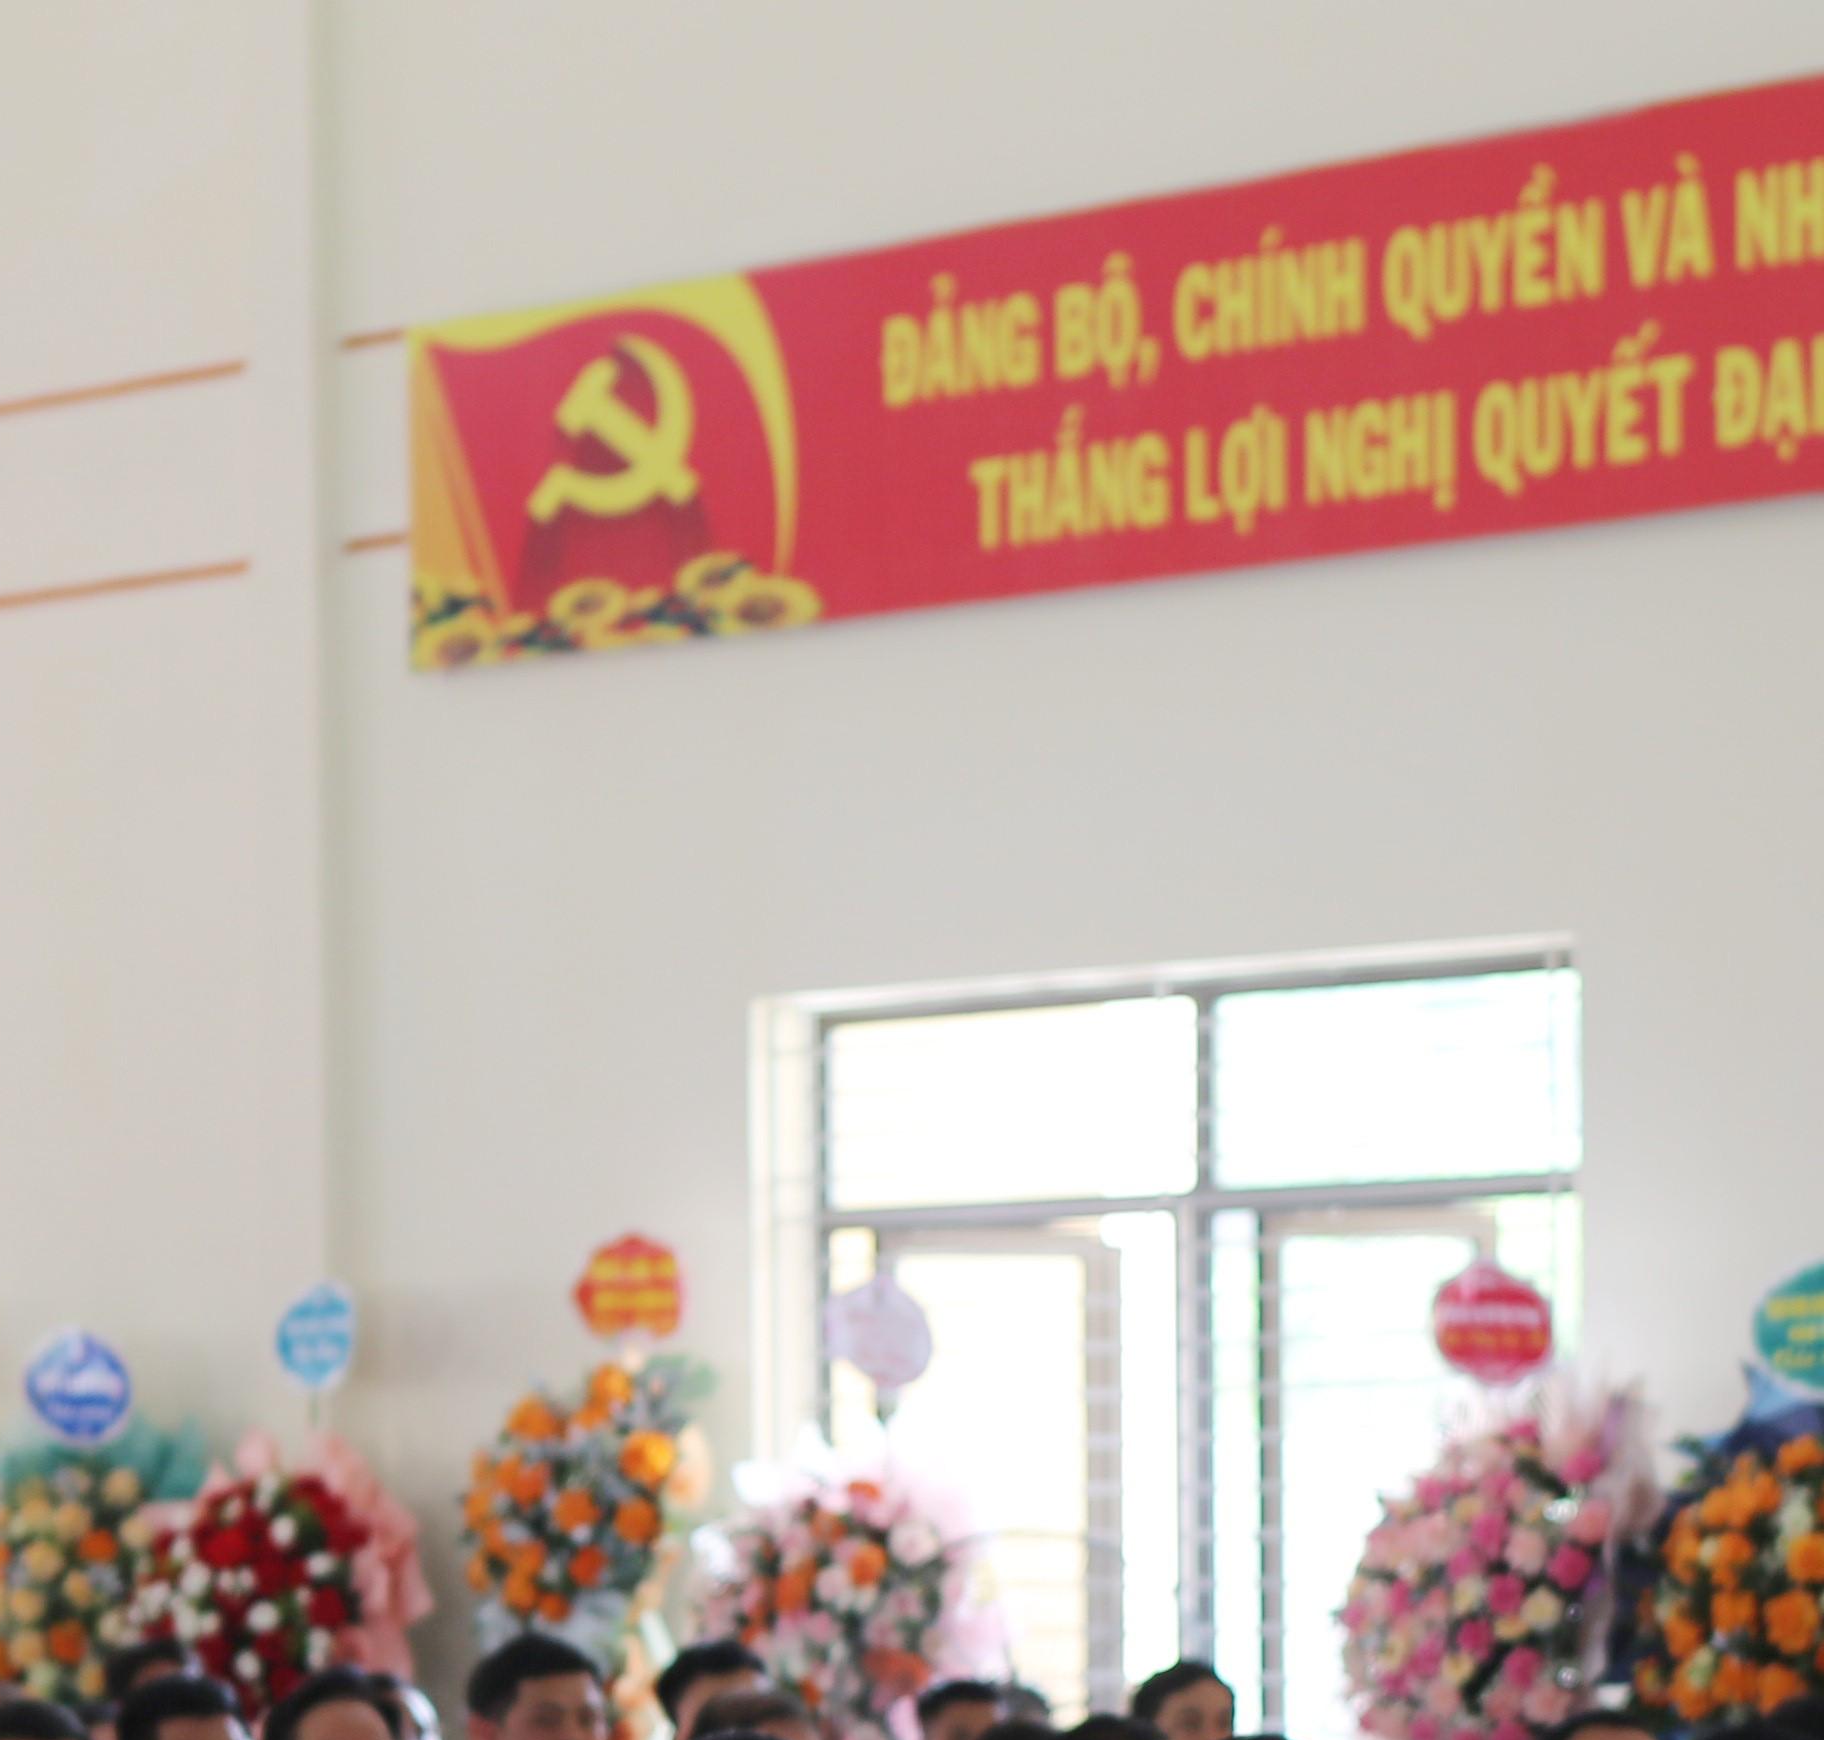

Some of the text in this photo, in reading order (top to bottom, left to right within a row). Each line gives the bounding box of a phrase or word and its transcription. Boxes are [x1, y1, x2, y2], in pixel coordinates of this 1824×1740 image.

[881, 272, 1042, 408] ĐẢNG
[1173, 226, 1366, 361] CHÍNH
[1621, 155, 1714, 287] VÀ
[970, 407, 1170, 549] THẮNG
[1185, 406, 1287, 533] LỢI
[1305, 391, 1456, 510] NGHỊ
[1473, 322, 1694, 495] QUYẾT
